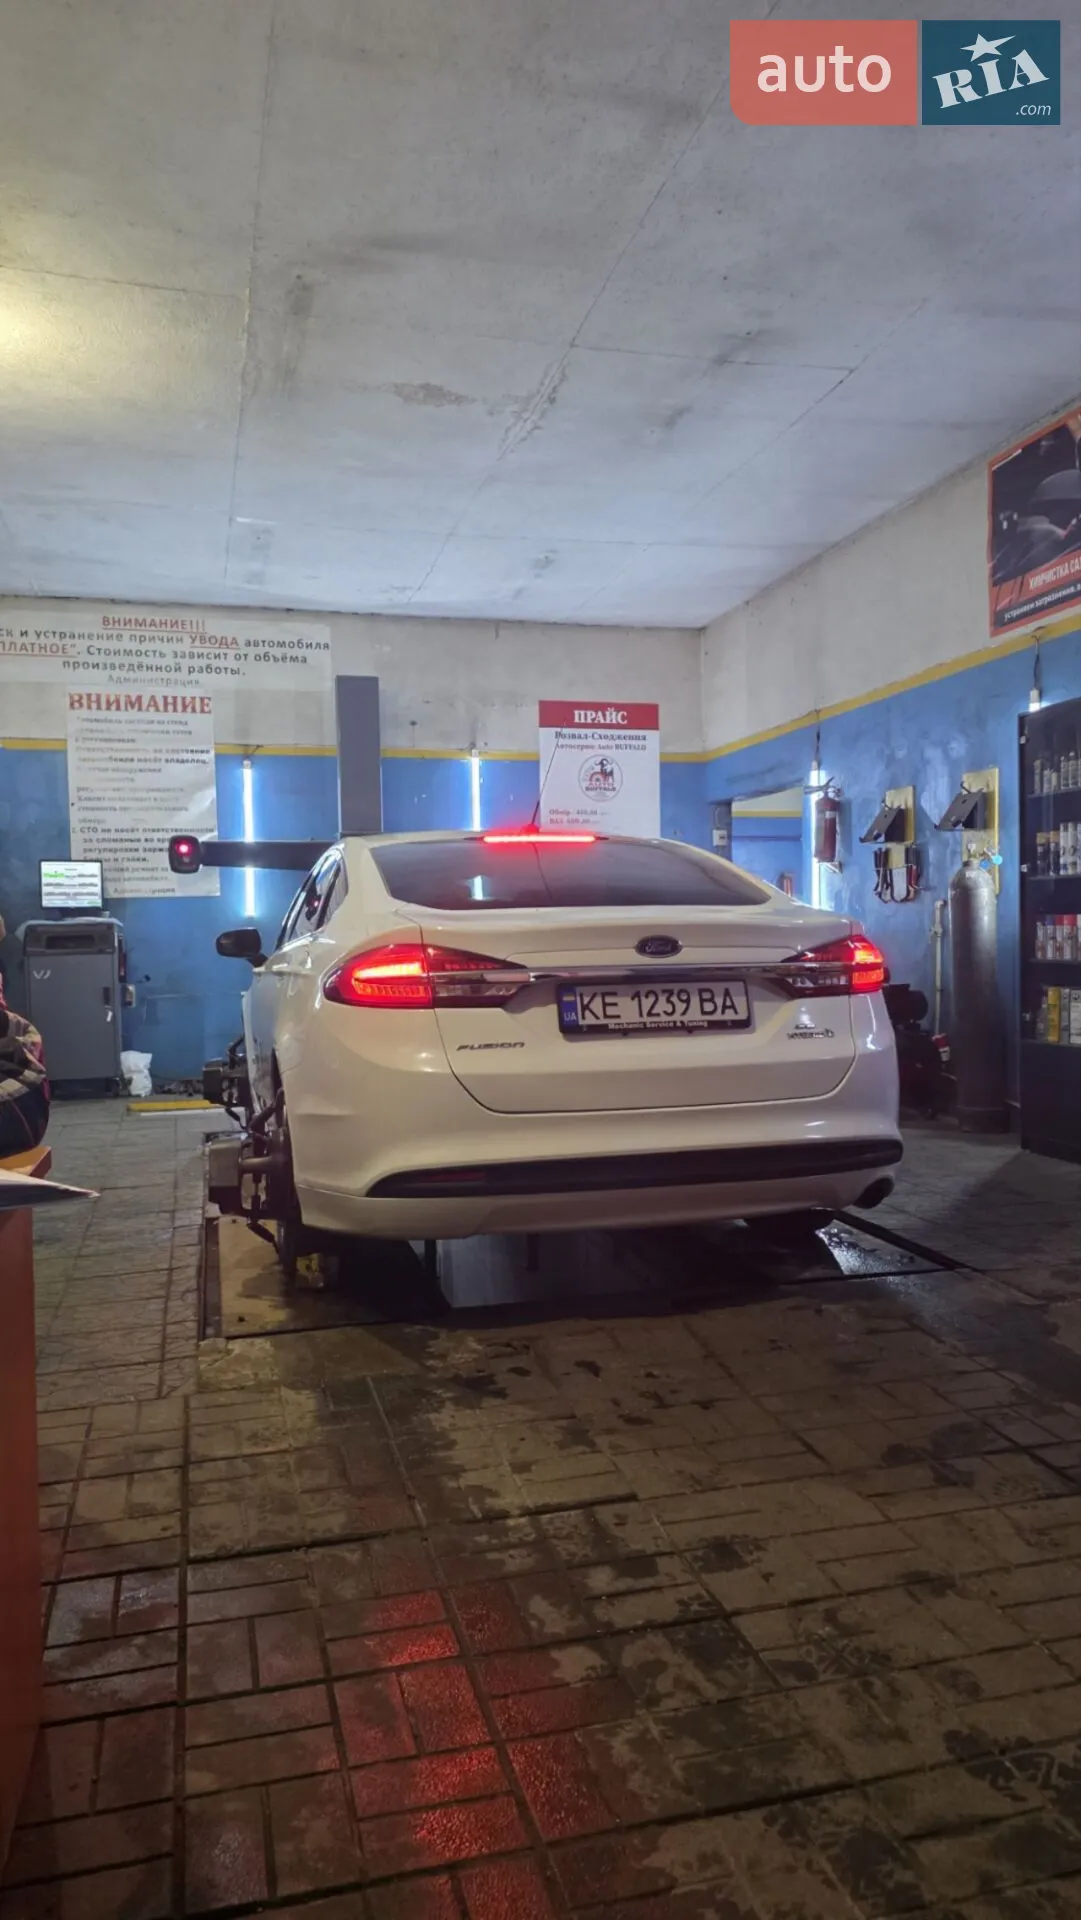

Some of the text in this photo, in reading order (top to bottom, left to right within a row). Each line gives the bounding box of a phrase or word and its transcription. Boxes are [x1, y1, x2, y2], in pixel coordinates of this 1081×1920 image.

[102, 615, 206, 632] ВНИМАНИЕ!!!
[20, 629, 28, 638] и
[34, 629, 124, 641] устранение
[129, 633, 184, 644] причин
[189, 635, 239, 648] УВОДА
[244, 638, 330, 650] автомобиля
[86, 644, 167, 659] Стоимость
[172, 650, 228, 661] зависит
[234, 653, 249, 662] от
[254, 651, 307, 664] объёма
[62, 660, 246, 676] произведённой работы.
[68, 692, 212, 714] ВНИМАНИЕ
[573, 707, 628, 724] ПРАЙС
[579, 987, 739, 1020] KE 1239 BA
[563, 1011, 577, 1021] UA
[646, 1020, 674, 1029] Service
[456, 1042, 525, 1052] FUSION
